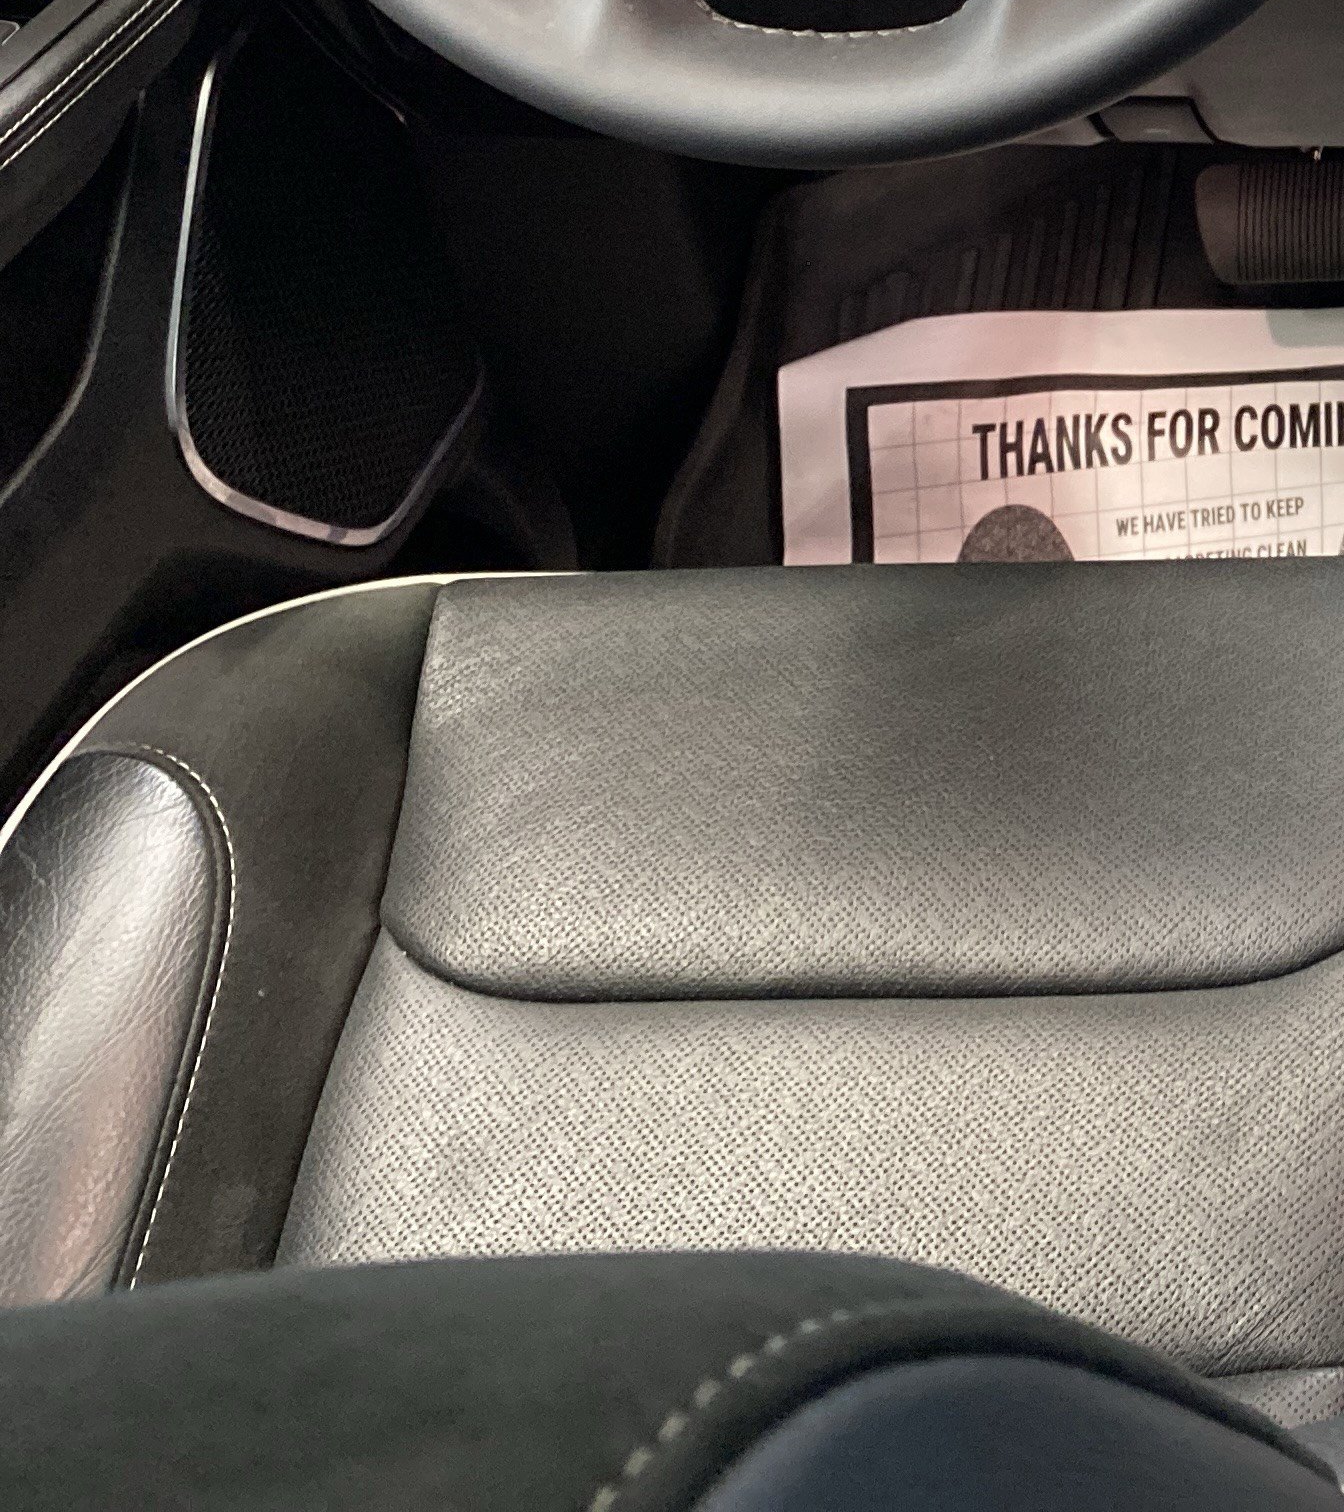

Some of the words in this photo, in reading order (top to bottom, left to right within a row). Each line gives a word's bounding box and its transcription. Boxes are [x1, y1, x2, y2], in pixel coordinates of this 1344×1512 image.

[972, 411, 1133, 481] THANKS
[1147, 407, 1220, 462] FOR
[1116, 516, 1139, 537] WE
[1143, 510, 1186, 534] HAVE
[1190, 505, 1235, 528] TRIED
[1239, 502, 1261, 522] TO
[1266, 496, 1304, 519] KEEP
